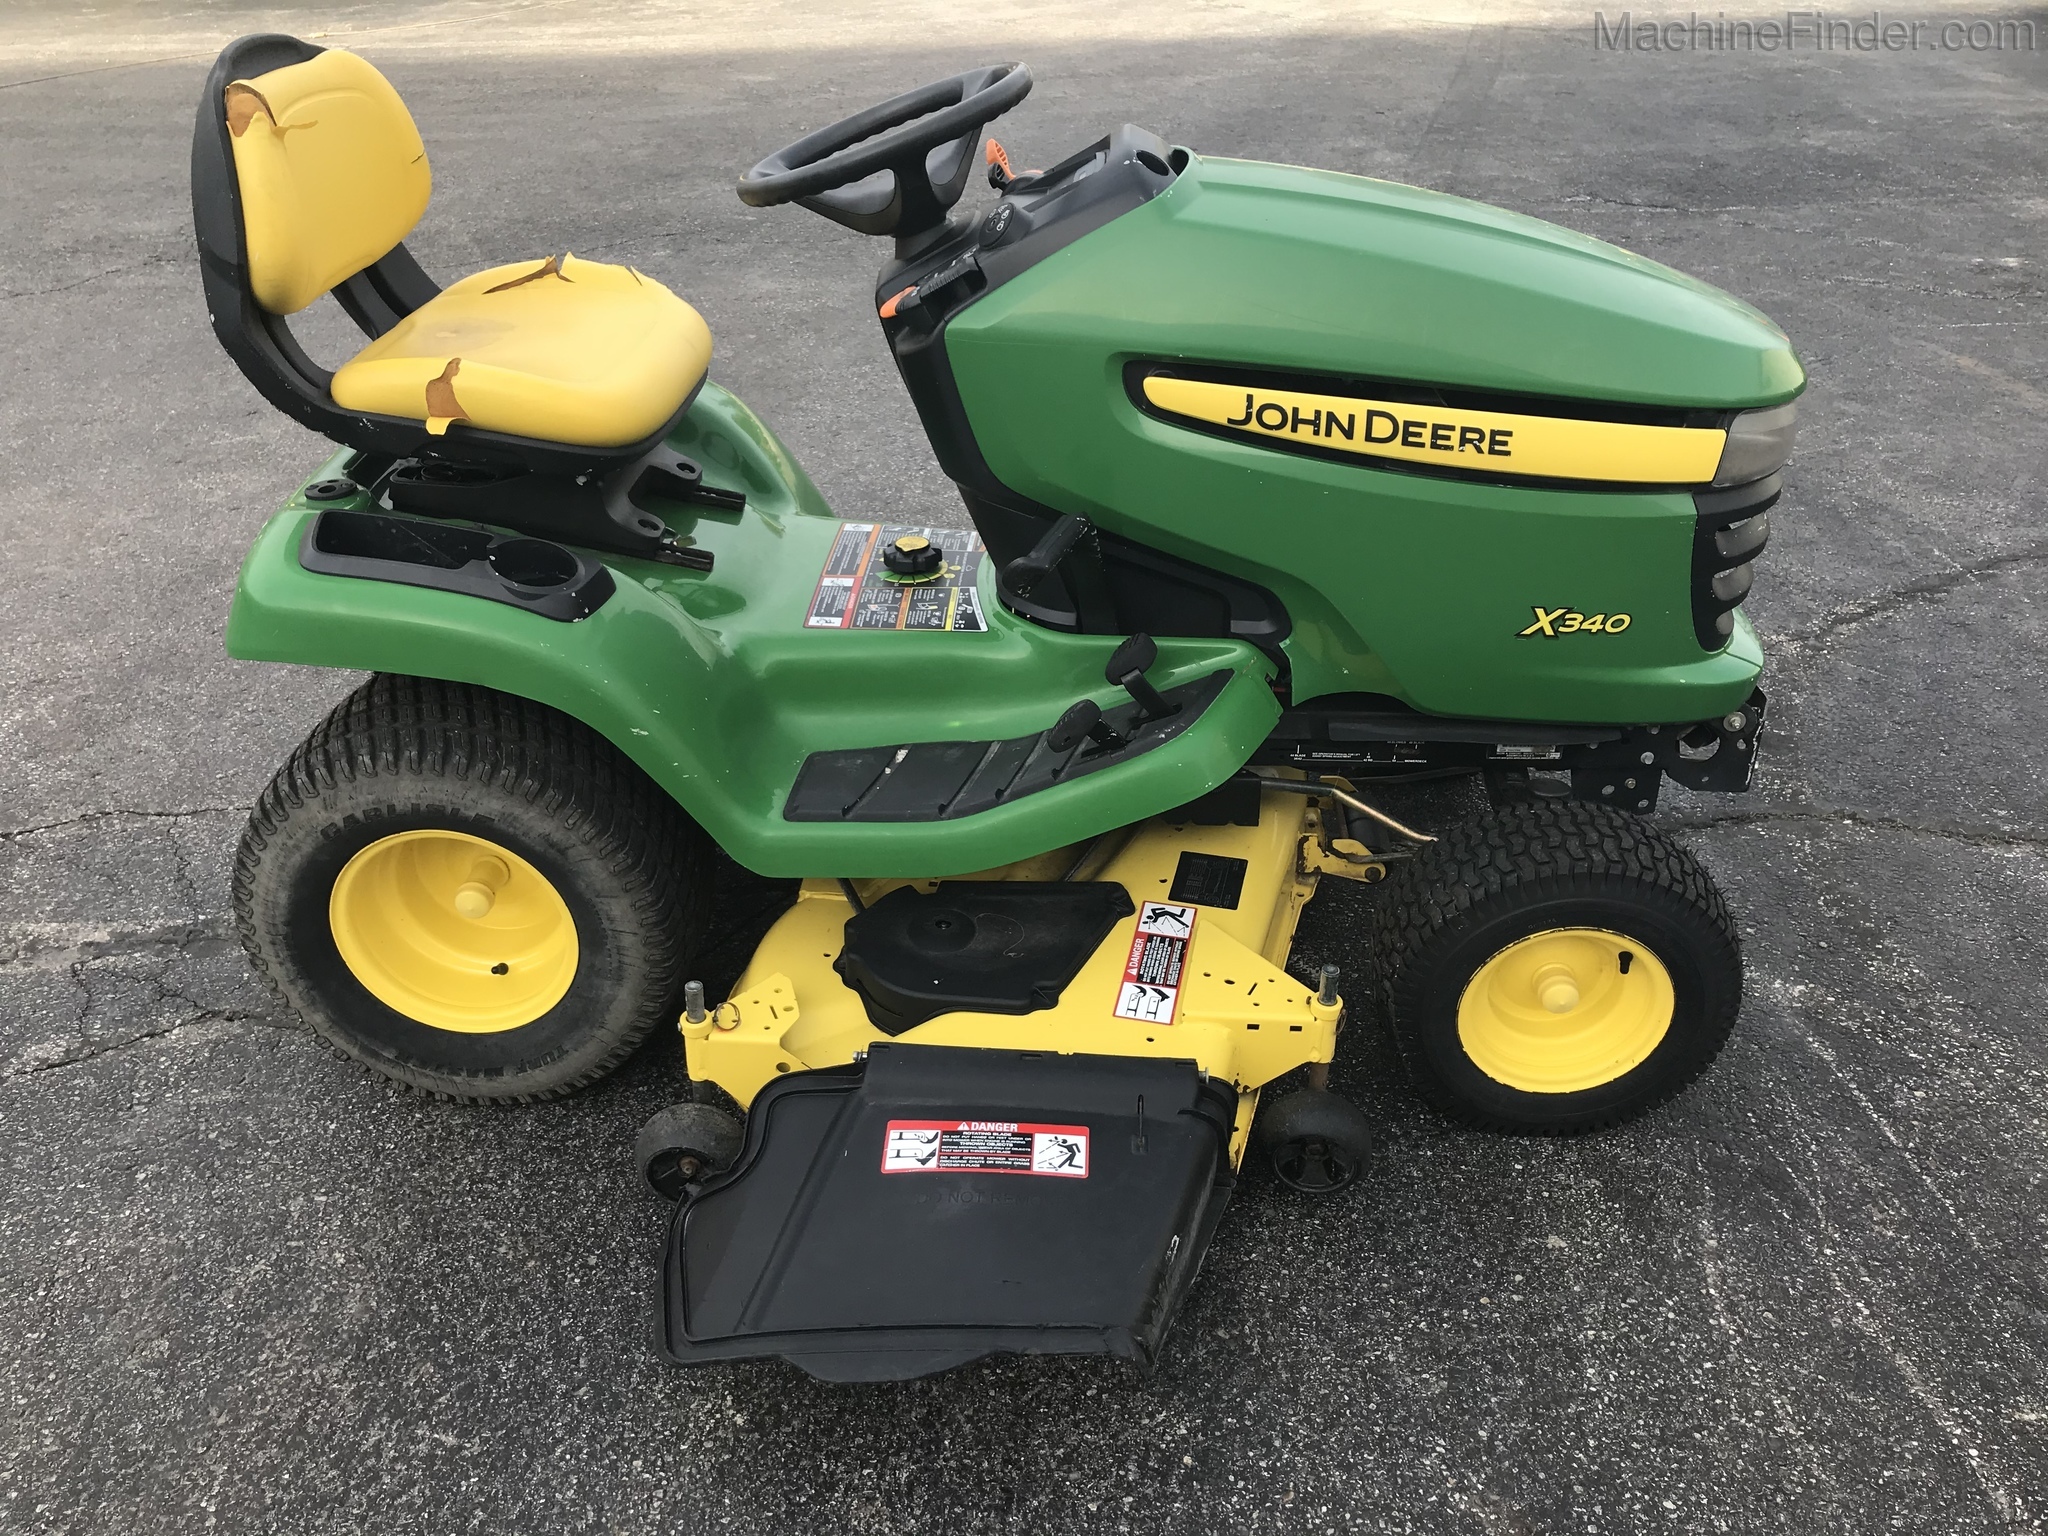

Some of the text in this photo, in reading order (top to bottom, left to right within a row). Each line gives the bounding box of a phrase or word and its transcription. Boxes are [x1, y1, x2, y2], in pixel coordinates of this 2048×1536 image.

[1227, 394, 1513, 457] JOHN DEERE
[1514, 606, 1632, 639] X340
[1130, 938, 1144, 967] DANGER
[971, 1122, 1018, 1132] DANGER
[948, 1191, 985, 1204] NOT
